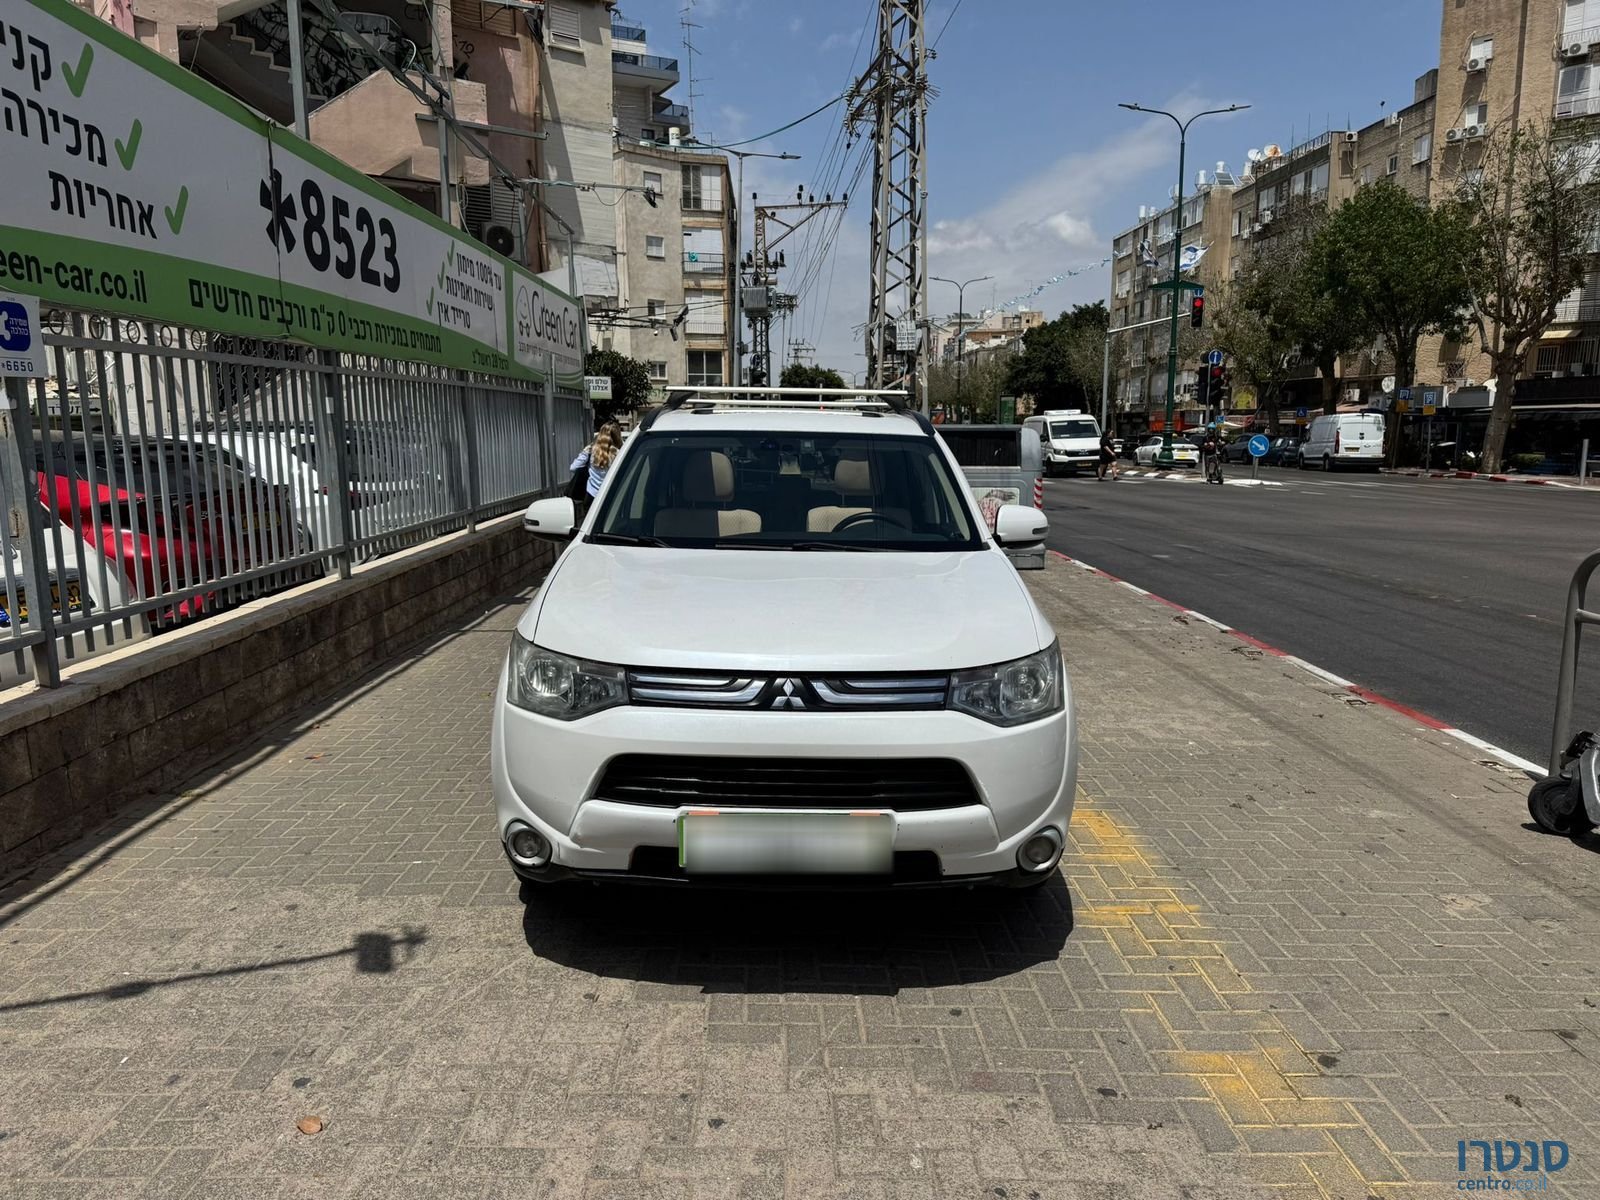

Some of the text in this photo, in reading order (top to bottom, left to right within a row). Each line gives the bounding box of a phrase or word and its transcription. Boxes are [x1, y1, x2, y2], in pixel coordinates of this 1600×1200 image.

[2, 88, 107, 167] מכירה
[48, 170, 157, 239] אחריות
[456, 252, 475, 279] מימון
[188, 278, 253, 318] חדשים
[446, 275, 493, 311] שירות ואמינות
[258, 294, 307, 329] ורכבים
[338, 309, 346, 337] 0
[437, 301, 471, 329] טרייד אין
[532, 290, 577, 349] Green Car
[348, 316, 373, 342] רכבי
[374, 321, 409, 347] במכירת
[410, 329, 441, 353] מתמחים
